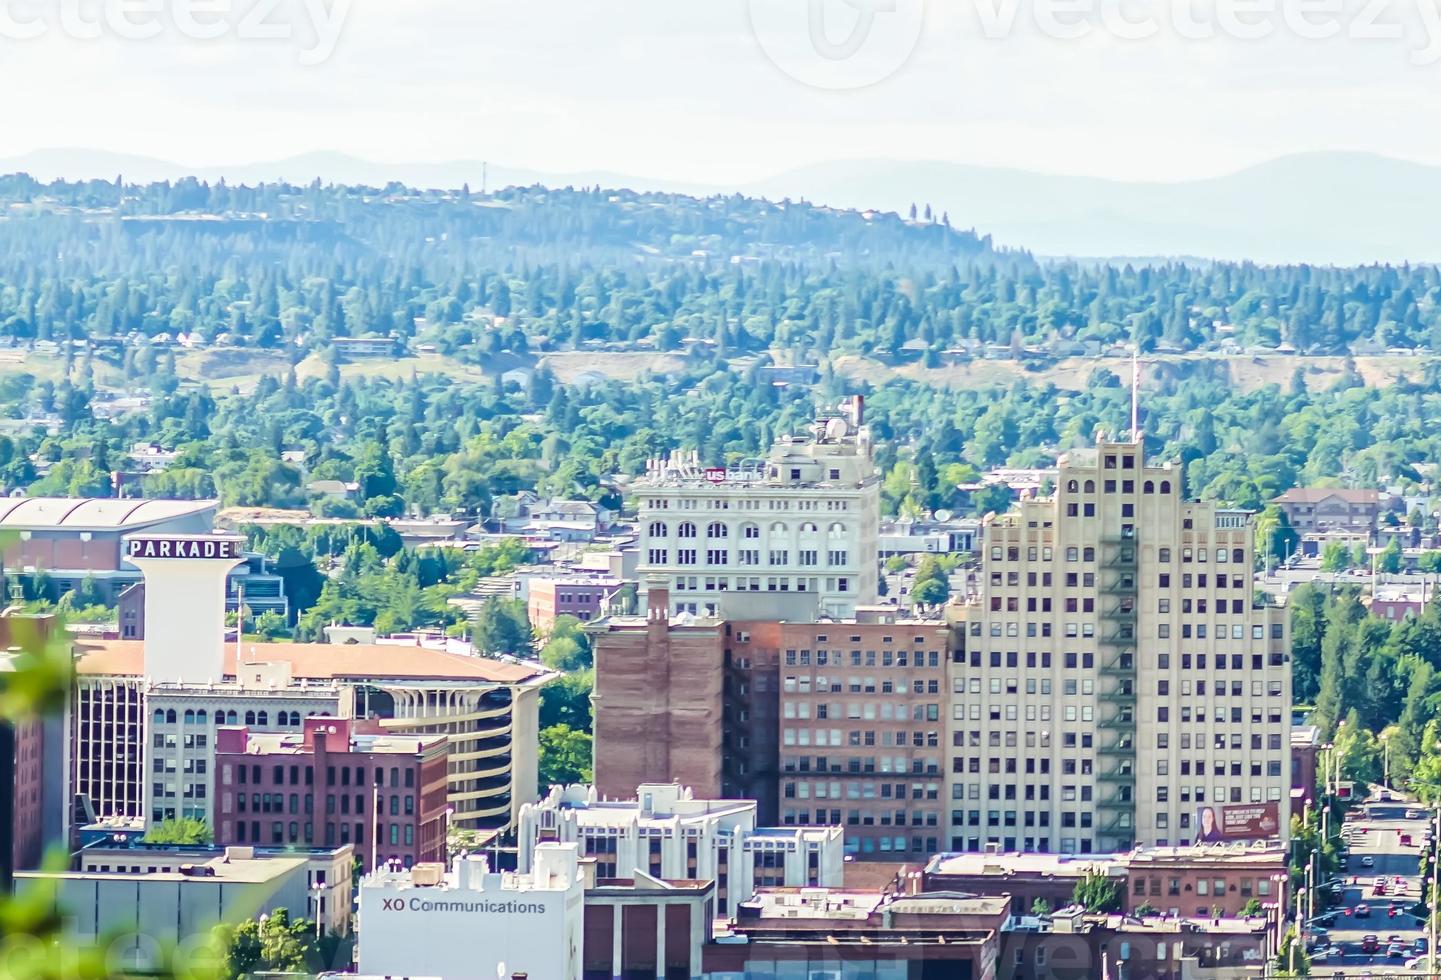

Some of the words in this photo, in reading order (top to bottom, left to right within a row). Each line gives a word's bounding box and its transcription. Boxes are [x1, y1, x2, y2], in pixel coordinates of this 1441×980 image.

[130, 541, 229, 557] PARKADE
[382, 898, 405, 911] XO
[409, 898, 546, 913] Communications
